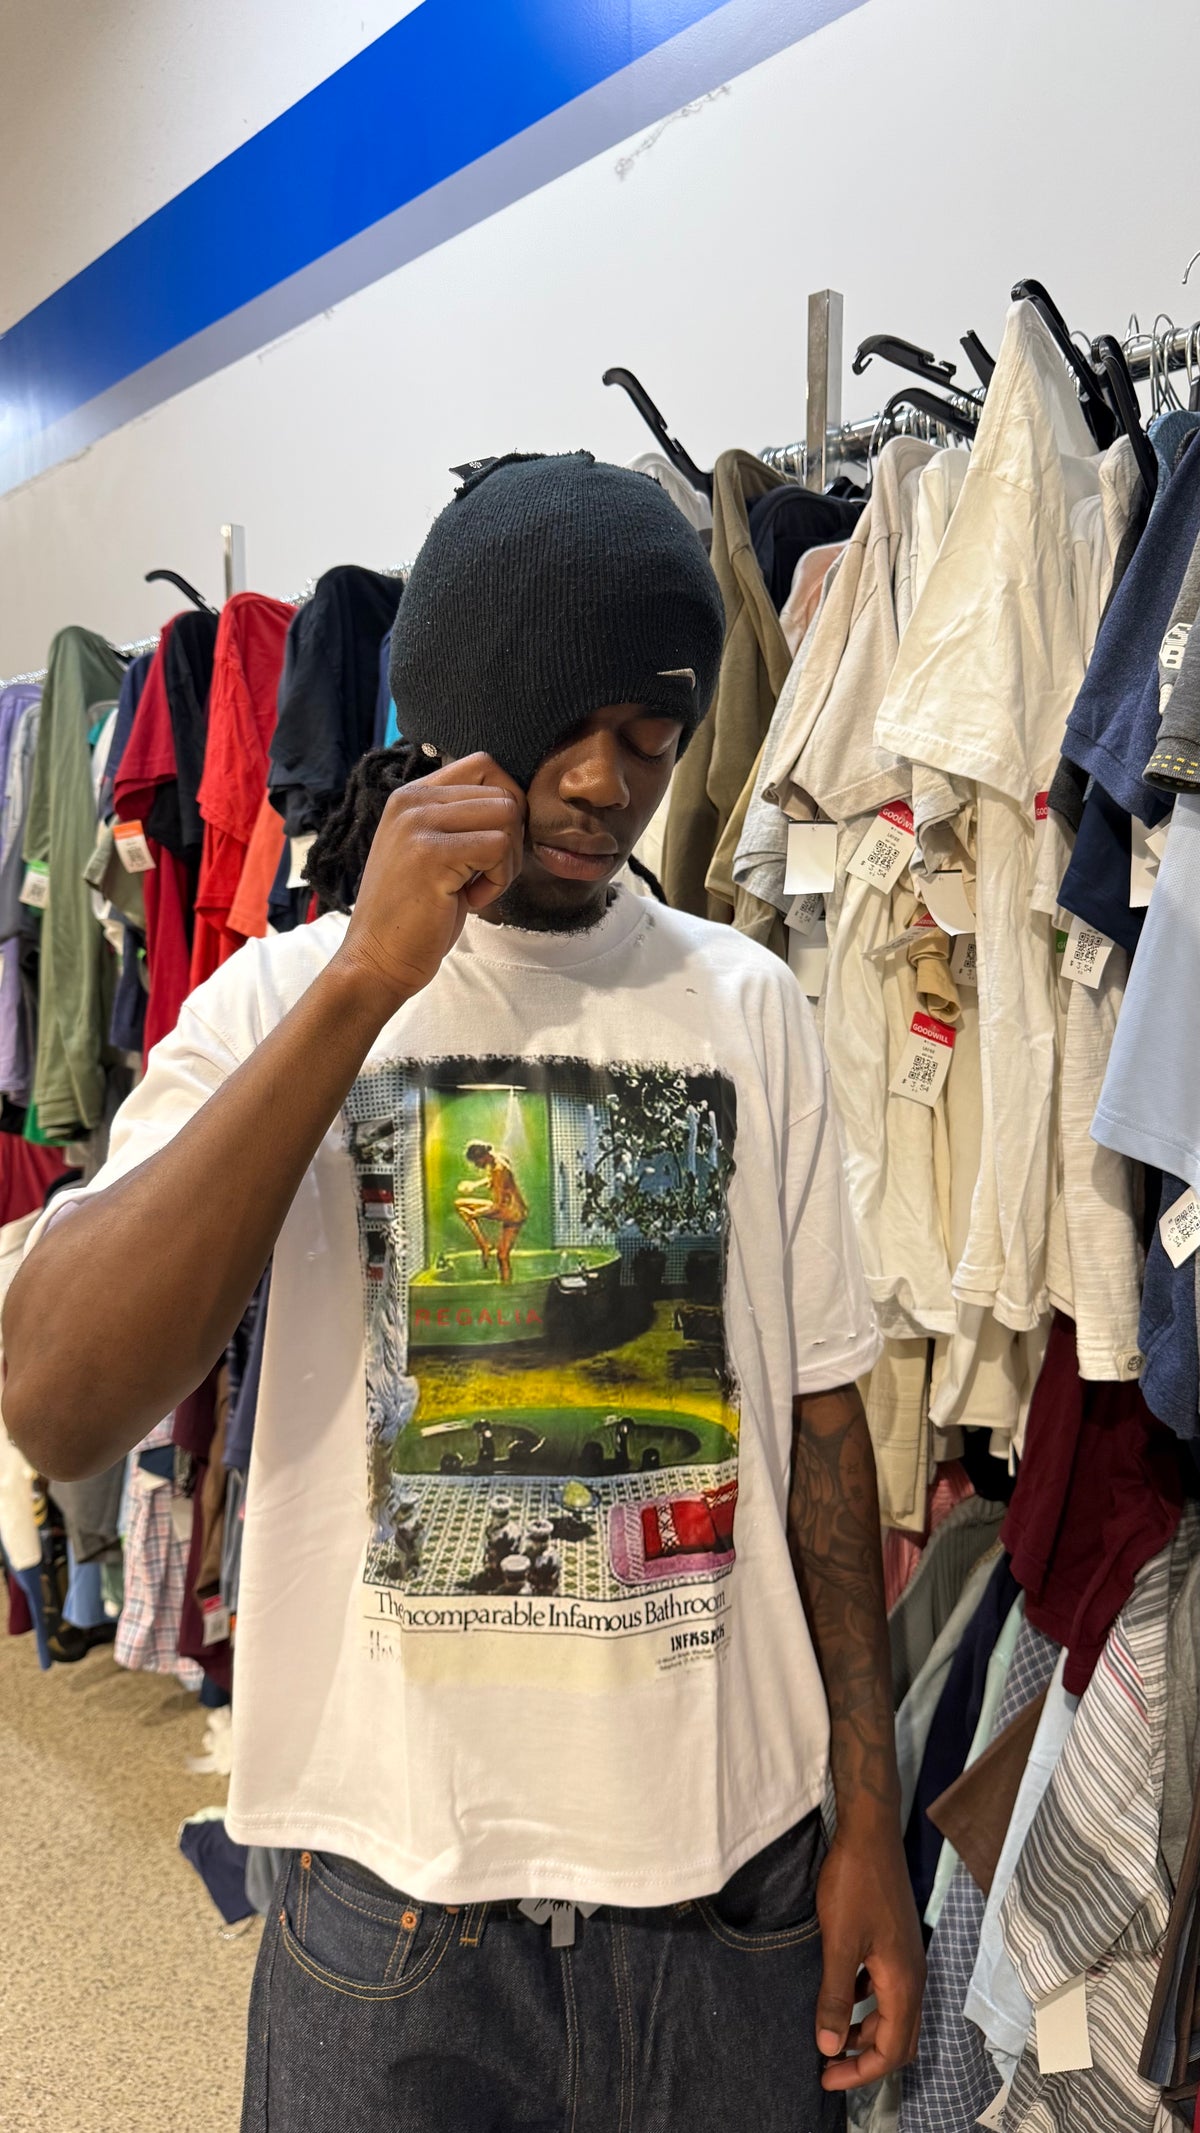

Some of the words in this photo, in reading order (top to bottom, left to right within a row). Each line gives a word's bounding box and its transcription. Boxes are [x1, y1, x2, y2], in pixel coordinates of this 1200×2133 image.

[912, 1023, 949, 1044] GOODWILL
[414, 1308, 544, 1327] REGALIA
[374, 1590, 404, 1620] The
[403, 1600, 545, 1632] ncomparable
[549, 1603, 642, 1632] Infamous
